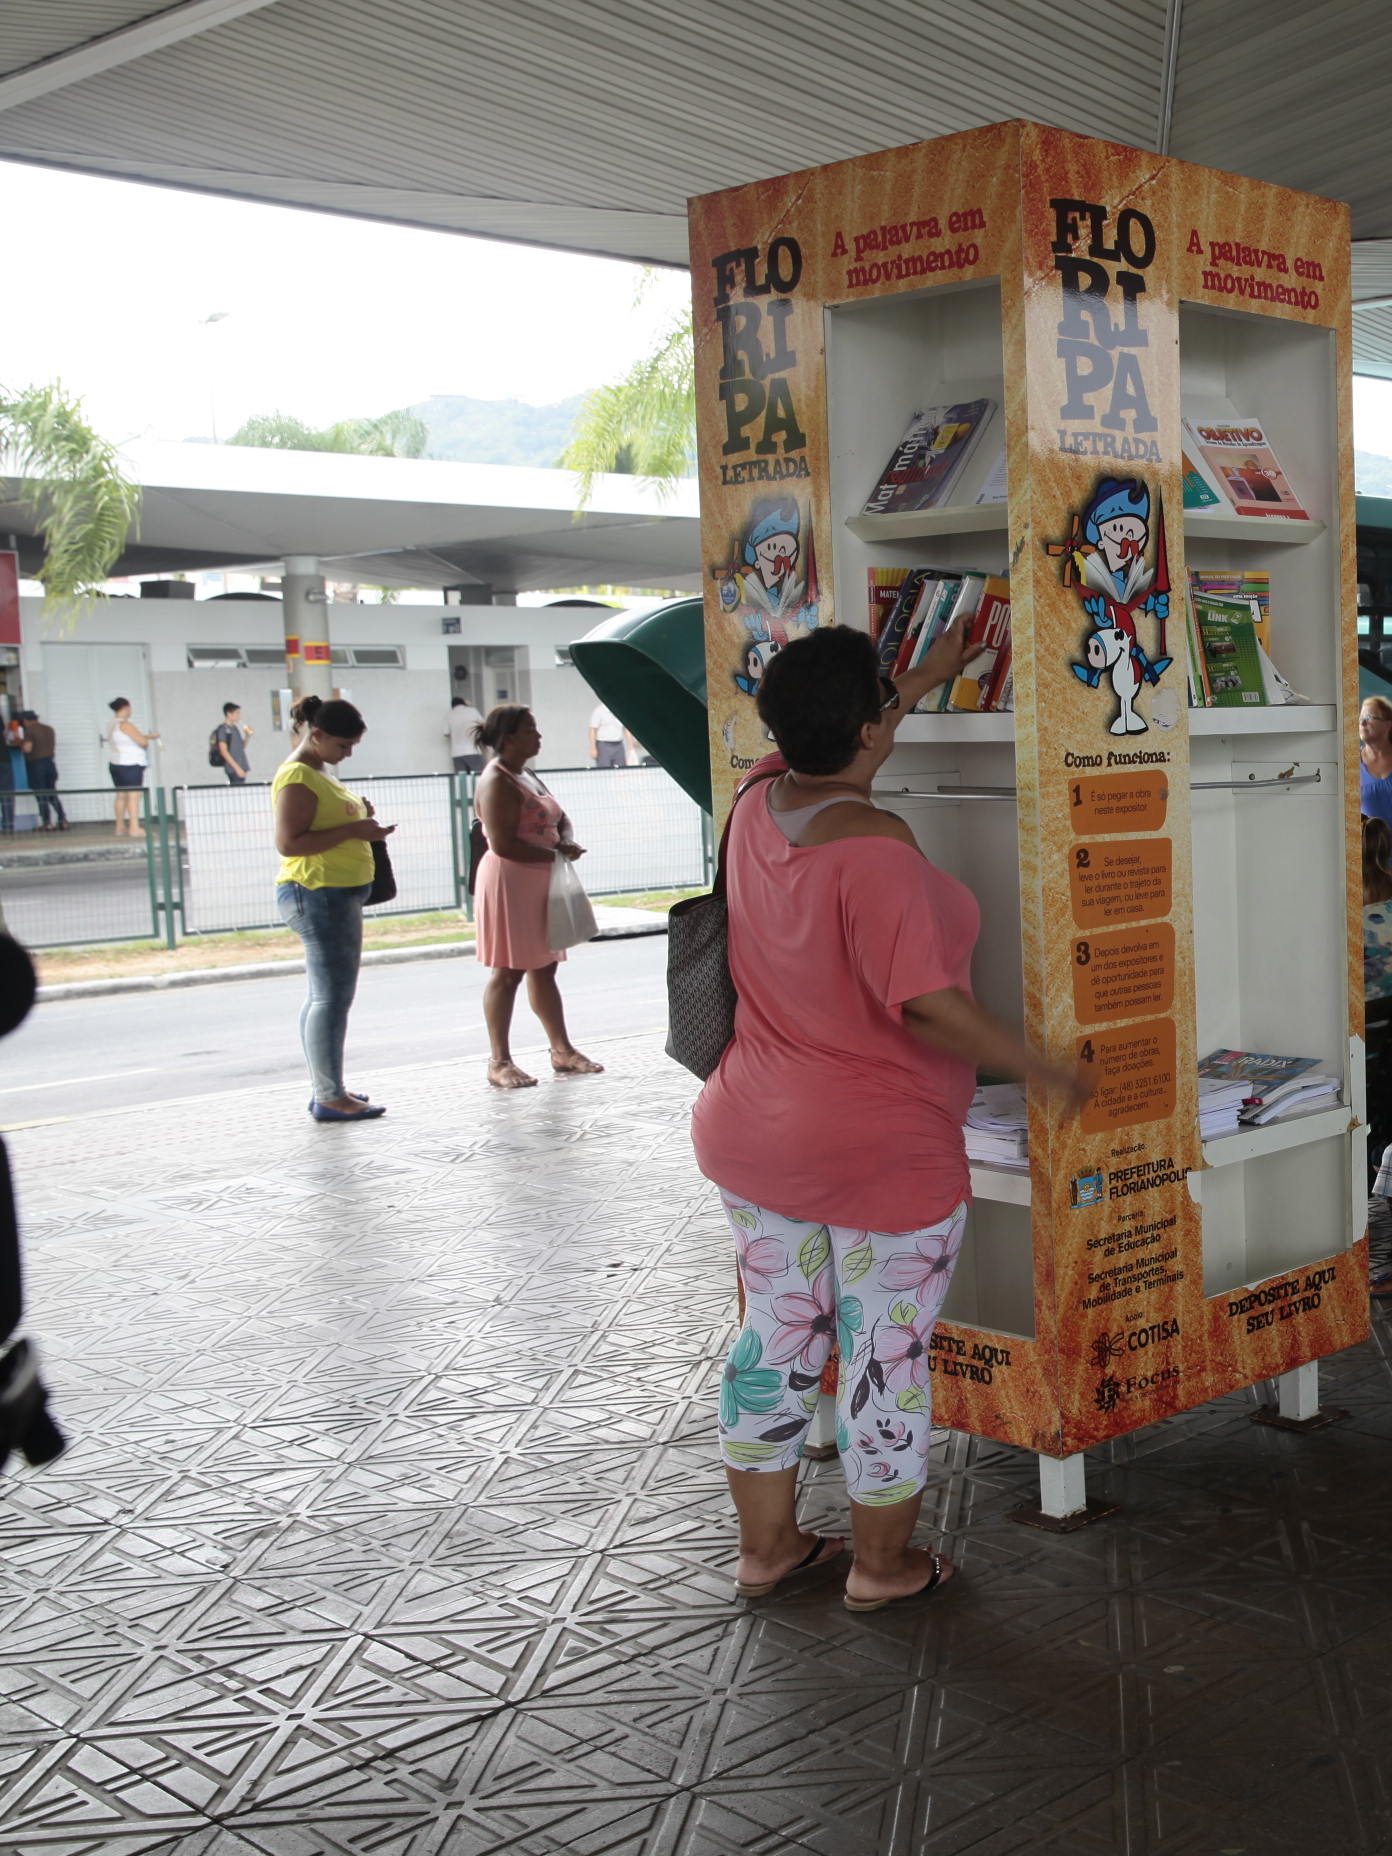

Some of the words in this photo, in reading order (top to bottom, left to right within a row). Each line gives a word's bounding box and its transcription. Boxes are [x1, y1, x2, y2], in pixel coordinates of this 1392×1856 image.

[831, 232, 848, 258] A
[853, 215, 942, 262] palavra
[947, 207, 987, 233] em
[1050, 198, 1156, 269] FLO
[846, 242, 980, 289] movimento
[1186, 229, 1203, 255] A
[1209, 241, 1289, 275] palavra
[1294, 254, 1325, 282] em
[711, 236, 803, 308] FLO
[1202, 269, 1320, 311] movimento
[1054, 254, 1149, 351] RI
[716, 298, 797, 381] RI
[1057, 338, 1158, 433] PA
[719, 377, 806, 456] PA
[1197, 426, 1263, 442] OBJETIVO
[1056, 429, 1163, 464] LETRADA
[720, 456, 811, 485] LETRADA
[1064, 752, 1102, 768] Como
[1106, 750, 1171, 767] funciona:
[1072, 784, 1082, 807] 1
[1090, 789, 1096, 801] É
[1097, 790, 1106, 801] só
[1107, 790, 1129, 803] pegar
[1130, 791, 1134, 799] a
[1135, 789, 1152, 799] obra
[1095, 804, 1114, 815] neste
[1076, 848, 1090, 868] 2
[1104, 856, 1114, 867] Se
[1079, 871, 1094, 882] leve
[1094, 873, 1099, 881] o
[1101, 869, 1116, 880] livro
[1117, 870, 1126, 878] ou
[1127, 867, 1149, 877] revista
[1151, 865, 1167, 876] para
[1084, 884, 1093, 894] ler
[1095, 881, 1121, 893] durante
[1123, 882, 1128, 890] o
[1129, 878, 1151, 890] trajeto
[1153, 876, 1162, 886] da
[1081, 898, 1094, 907] sua
[1124, 893, 1134, 902] ou
[1134, 891, 1149, 901] leve
[1150, 889, 1166, 901] para
[1103, 906, 1112, 916] ler
[1114, 907, 1125, 915] em
[1076, 941, 1091, 966] 3
[1094, 944, 1120, 958] Depois
[1121, 942, 1147, 954] devolva
[1149, 941, 1160, 951] em
[1091, 963, 1103, 973] um
[1104, 959, 1117, 970] dos
[1118, 955, 1158, 970] expositores
[1158, 954, 1164, 962] e
[1091, 974, 1101, 985] dê
[1101, 968, 1148, 985] oportunidade
[1149, 967, 1165, 980] para
[1095, 988, 1109, 1000] que
[1110, 984, 1131, 997] outras
[1133, 981, 1162, 995] pessoas
[1094, 1000, 1124, 1013] também
[1124, 996, 1152, 1012] possam
[1080, 1040, 1095, 1063] 4
[1100, 1043, 1117, 1055] Para
[1118, 1038, 1151, 1052] aumentar
[1152, 1037, 1158, 1045] o
[1100, 1053, 1127, 1066] número
[1128, 1050, 1138, 1060] de
[1104, 1063, 1121, 1076] faça
[1119, 1081, 1134, 1094] (48)
[1094, 1099, 1100, 1109] A
[1101, 1095, 1126, 1108] cidade
[1111, 1143, 1147, 1157] Realização:
[1109, 1157, 1175, 1185] PREFEITURA
[1118, 1210, 1146, 1223] Parceria:
[1087, 1229, 1132, 1250] Secretaria
[1135, 1215, 1177, 1236] Municipal
[1104, 1246, 1116, 1257] de
[1118, 1234, 1161, 1255] Educação
[1088, 1263, 1134, 1285] Secretaria
[1136, 1248, 1178, 1270] Municipal
[1100, 1281, 1111, 1292] de
[1114, 1265, 1168, 1288] Transportes,
[1082, 1288, 1133, 1311] Mobilidade
[1135, 1285, 1141, 1294] e
[1143, 1270, 1184, 1291] Terminais
[1228, 1279, 1300, 1317] DEPOSITE
[1303, 1267, 1336, 1292] AQUI
[1125, 1312, 1144, 1322] Apoio:
[1246, 1310, 1274, 1334] SEU
[1279, 1293, 1321, 1321] LIVRO
[1128, 1318, 1180, 1351] COTISA
[970, 1344, 1011, 1368] AQUI
[941, 1358, 992, 1385] LIVRO
